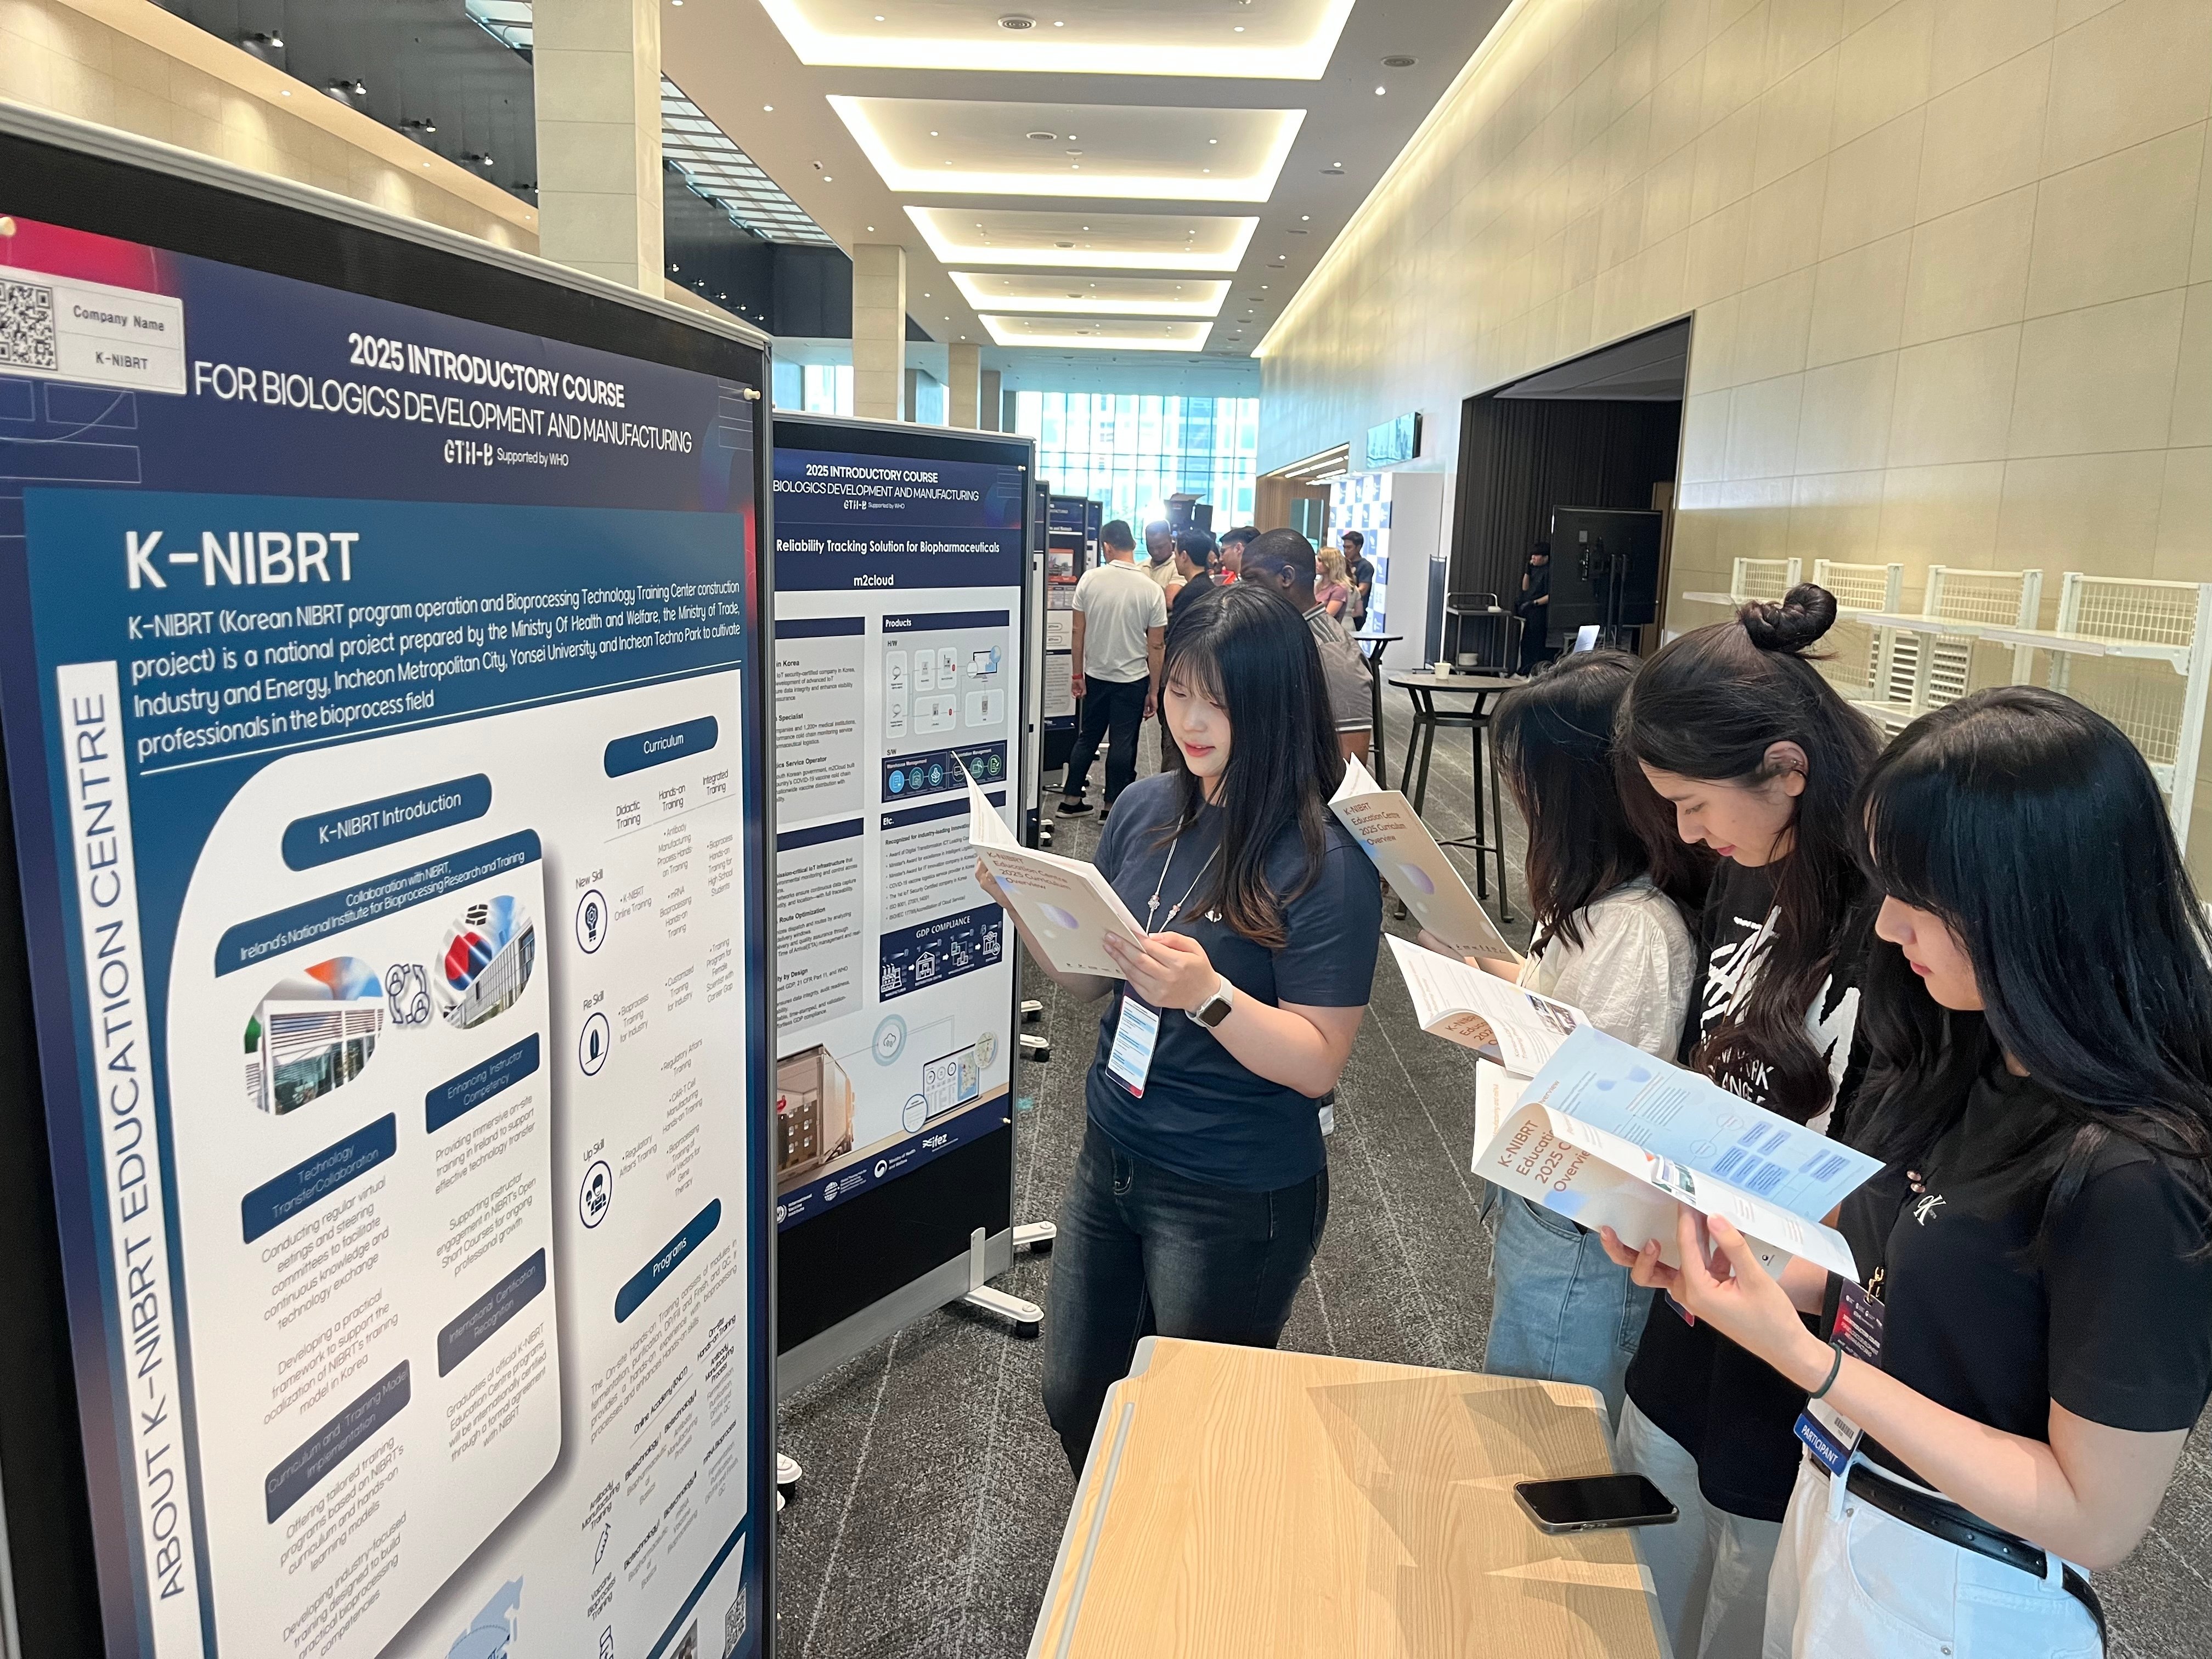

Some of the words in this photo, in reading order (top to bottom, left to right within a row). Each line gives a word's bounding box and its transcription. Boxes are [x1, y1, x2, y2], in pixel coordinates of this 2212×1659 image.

[73, 304, 128, 326] Company
[133, 314, 165, 332] Name
[95, 352, 148, 370] K-NIBRT
[348, 332, 404, 372] 2025
[408, 343, 560, 397] INTRODUCTORY
[562, 373, 625, 408] COURSE
[194, 360, 257, 403] FOR
[263, 370, 400, 419] BIOLOGICS
[405, 391, 545, 436] DEVELOPMENT
[548, 413, 581, 440] AND
[583, 417, 692, 454] MANUFACTURING
[497, 448, 538, 466] Supported
[539, 450, 549, 466] by
[549, 452, 569, 466] WHO
[806, 464, 828, 477] 2025
[830, 465, 902, 481] INTRODUCTORY
[903, 471, 938, 483] COURSE
[773, 479, 826, 494] BIOLOGICS
[827, 483, 893, 497] DEVELOPMENT
[894, 487, 912, 499] AND
[913, 488, 979, 501] MANUFACTURING
[776, 539, 825, 554] Reliability
[827, 540, 867, 555] Tracking
[870, 540, 904, 552] Solution
[906, 541, 918, 552] for
[920, 541, 1000, 555] Biopharmaceuticals
[126, 531, 359, 589] K-NIBRT
[854, 574, 894, 586] m2cloud
[129, 611, 214, 640] K-NIBRT
[220, 610, 293, 633] (Korean
[296, 605, 345, 627] NIBRT
[349, 603, 412, 628] program
[415, 596, 478, 622] operation
[481, 593, 504, 612] and
[506, 589, 580, 613] Bioprocessing
[582, 586, 635, 606] Technology
[637, 584, 670, 602] Training
[671, 583, 696, 598] Center
[698, 580, 740, 596] construction
[885, 619, 912, 628] Products
[132, 647, 216, 686] project)
[223, 647, 238, 670] is
[245, 650, 258, 667] a
[265, 639, 334, 664] national
[340, 633, 395, 662] project
[400, 626, 464, 654] prepared
[467, 624, 484, 646] by
[488, 623, 507, 640] the
[511, 619, 552, 639] Ministry
[556, 616, 568, 633] Of
[571, 613, 602, 632] Health
[606, 611, 624, 627] and
[627, 608, 660, 625] Welfare,
[663, 608, 675, 621] the
[679, 605, 706, 620] Ministry
[708, 603, 716, 617] of
[718, 602, 740, 617] Trade,
[134, 689, 218, 718] Industry
[223, 681, 261, 707] and
[266, 676, 331, 701] Energy,
[335, 666, 394, 690] Incheon
[398, 651, 479, 681] Metropolitan
[482, 651, 507, 673] City,
[511, 646, 546, 665] Yonsei
[548, 639, 597, 660] University,
[600, 636, 617, 653] and
[619, 634, 653, 651] Incheon
[654, 630, 684, 647] Techno
[685, 629, 701, 642] Park
[703, 626, 710, 639] to
[713, 624, 740, 638] cultivate
[138, 715, 269, 763] professionals
[273, 713, 287, 733] in
[290, 709, 317, 731] the
[321, 698, 404, 727] bioprocess
[407, 690, 435, 710] field
[778, 713, 804, 721] Specialist
[644, 734, 684, 754] Curriculum
[703, 769, 728, 785] Integrated
[659, 785, 685, 800] Hands-on
[707, 782, 726, 795] Training
[72, 694, 121, 908] CENTRE
[616, 800, 640, 816] Didactic
[663, 797, 684, 811] Training
[1344, 802, 1370, 816] K-NIBRT
[319, 812, 379, 844] K-NIBRT
[382, 792, 461, 827] Introduction
[617, 814, 641, 829] Training
[883, 817, 895, 826] Etc.
[1351, 812, 1383, 825] Education
[1359, 824, 1378, 836] 2025
[1367, 834, 1396, 845] Overview
[576, 875, 590, 888] New
[999, 869, 1024, 878] 2025
[1006, 878, 1046, 889] Overview
[346, 874, 408, 907] Collaboration
[408, 868, 425, 884] with
[240, 933, 287, 961] Ireland's
[288, 918, 330, 944] National
[331, 906, 369, 928] Institute
[369, 900, 384, 915] for
[385, 879, 444, 911] Bioprocessing
[444, 867, 481, 887] Research
[482, 860, 496, 874] and
[496, 850, 524, 870] Training
[780, 914, 794, 923] Route
[795, 907, 826, 919] Optimization
[916, 928, 929, 938] GDP
[931, 915, 970, 934] COMPLIANCE
[791, 969, 808, 978] Design
[583, 1000, 592, 1010] Re
[1474, 1029, 1493, 1041] 202
[94, 920, 149, 1223] EDUCATION
[448, 1070, 487, 1099] Enhancing
[489, 1049, 523, 1075] Instructor
[464, 1073, 510, 1105] Competency
[1497, 1120, 1538, 1167] K-NIBRT
[1516, 1130, 1554, 1176] Educati
[298, 1146, 354, 1183] Technology
[583, 1152, 593, 1161] Up
[1534, 1150, 1564, 1184] 2025
[1554, 1150, 1592, 1192] Overvie
[262, 1220, 320, 1263] Conducting
[322, 1197, 357, 1226] regular
[359, 1178, 386, 1201] virtual
[316, 1228, 334, 1247] and
[337, 1203, 374, 1233] steering
[653, 1237, 687, 1277] Programs
[278, 1286, 331, 1330] technology
[334, 1253, 378, 1290] exchange
[125, 1235, 168, 1436] K-NIBRT
[1801, 1425, 1838, 1464] PARTICIPANT
[145, 1443, 185, 1600] ABOUT
